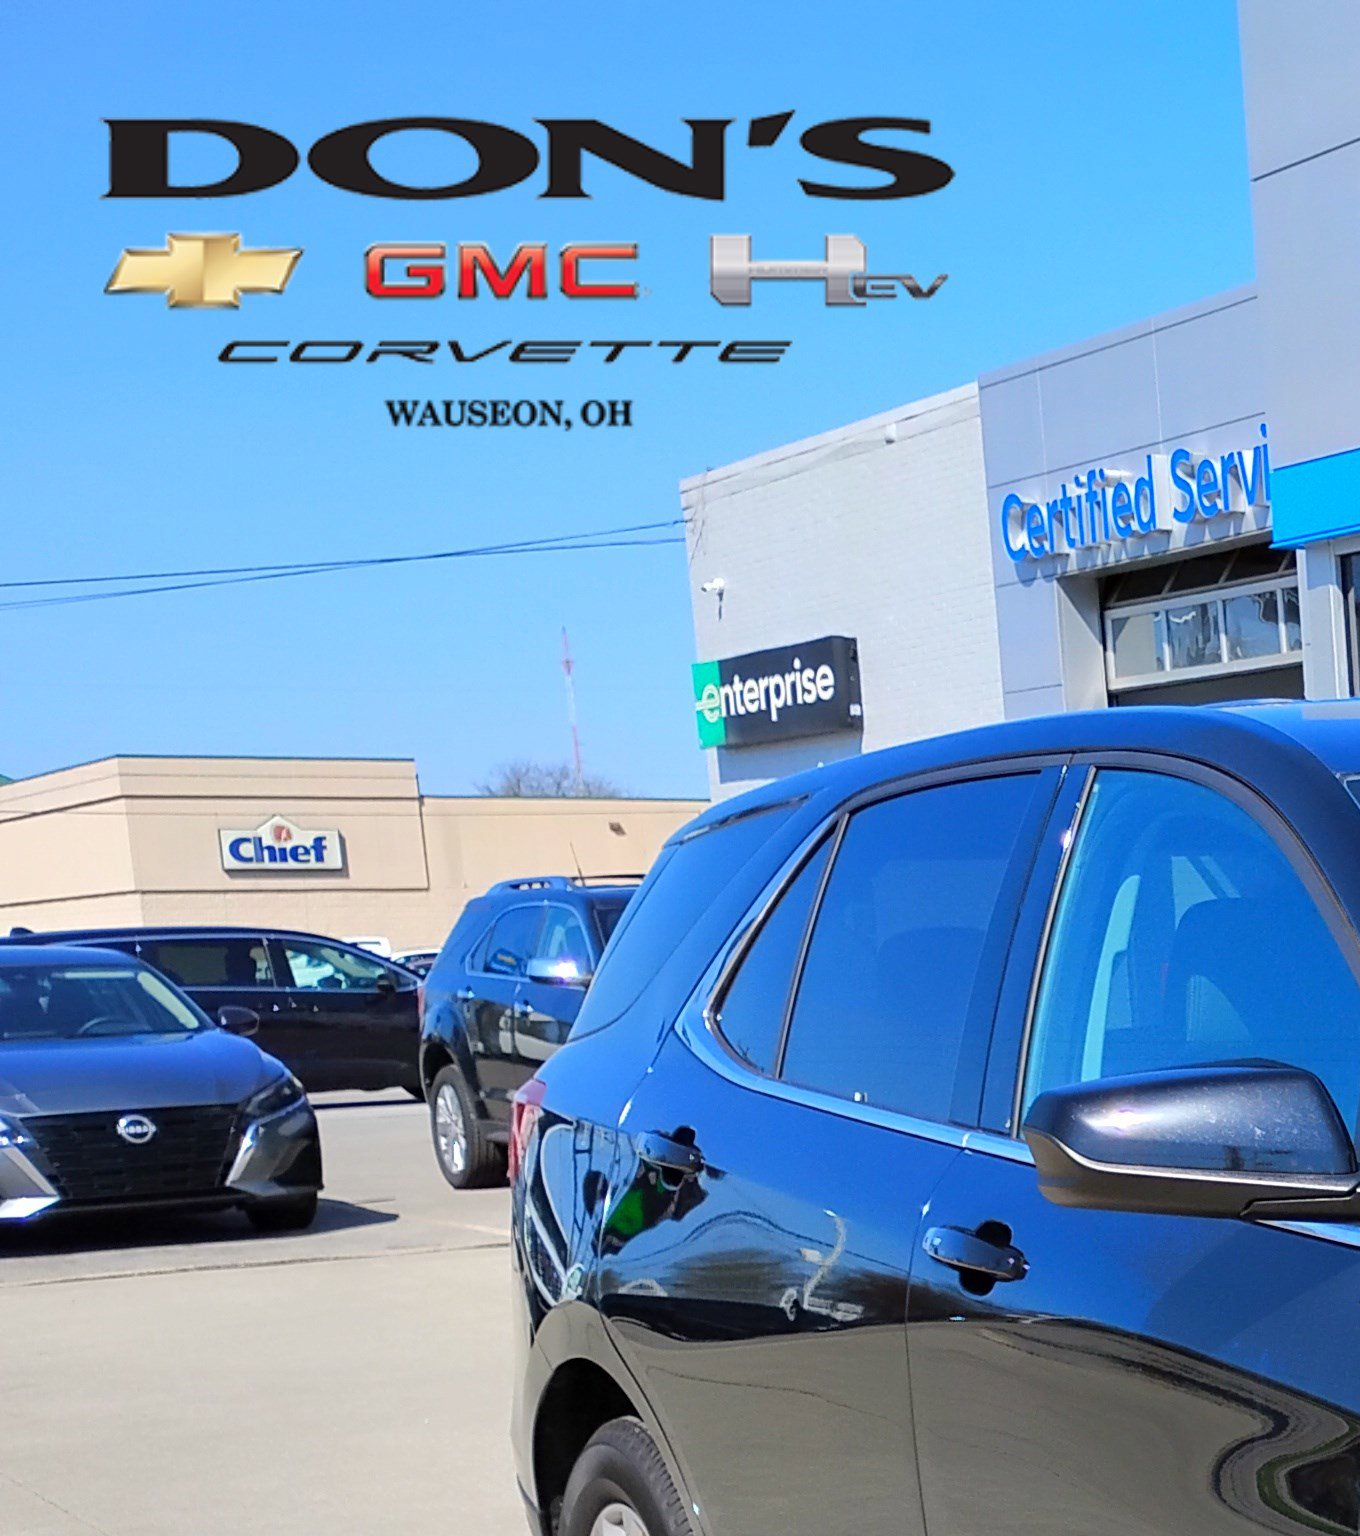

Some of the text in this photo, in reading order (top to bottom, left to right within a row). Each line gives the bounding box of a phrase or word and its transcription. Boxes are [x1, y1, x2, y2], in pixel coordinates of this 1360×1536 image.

[1001, 453, 1158, 562] Certified
[695, 657, 836, 724] enterprise
[228, 835, 328, 864] Chief
